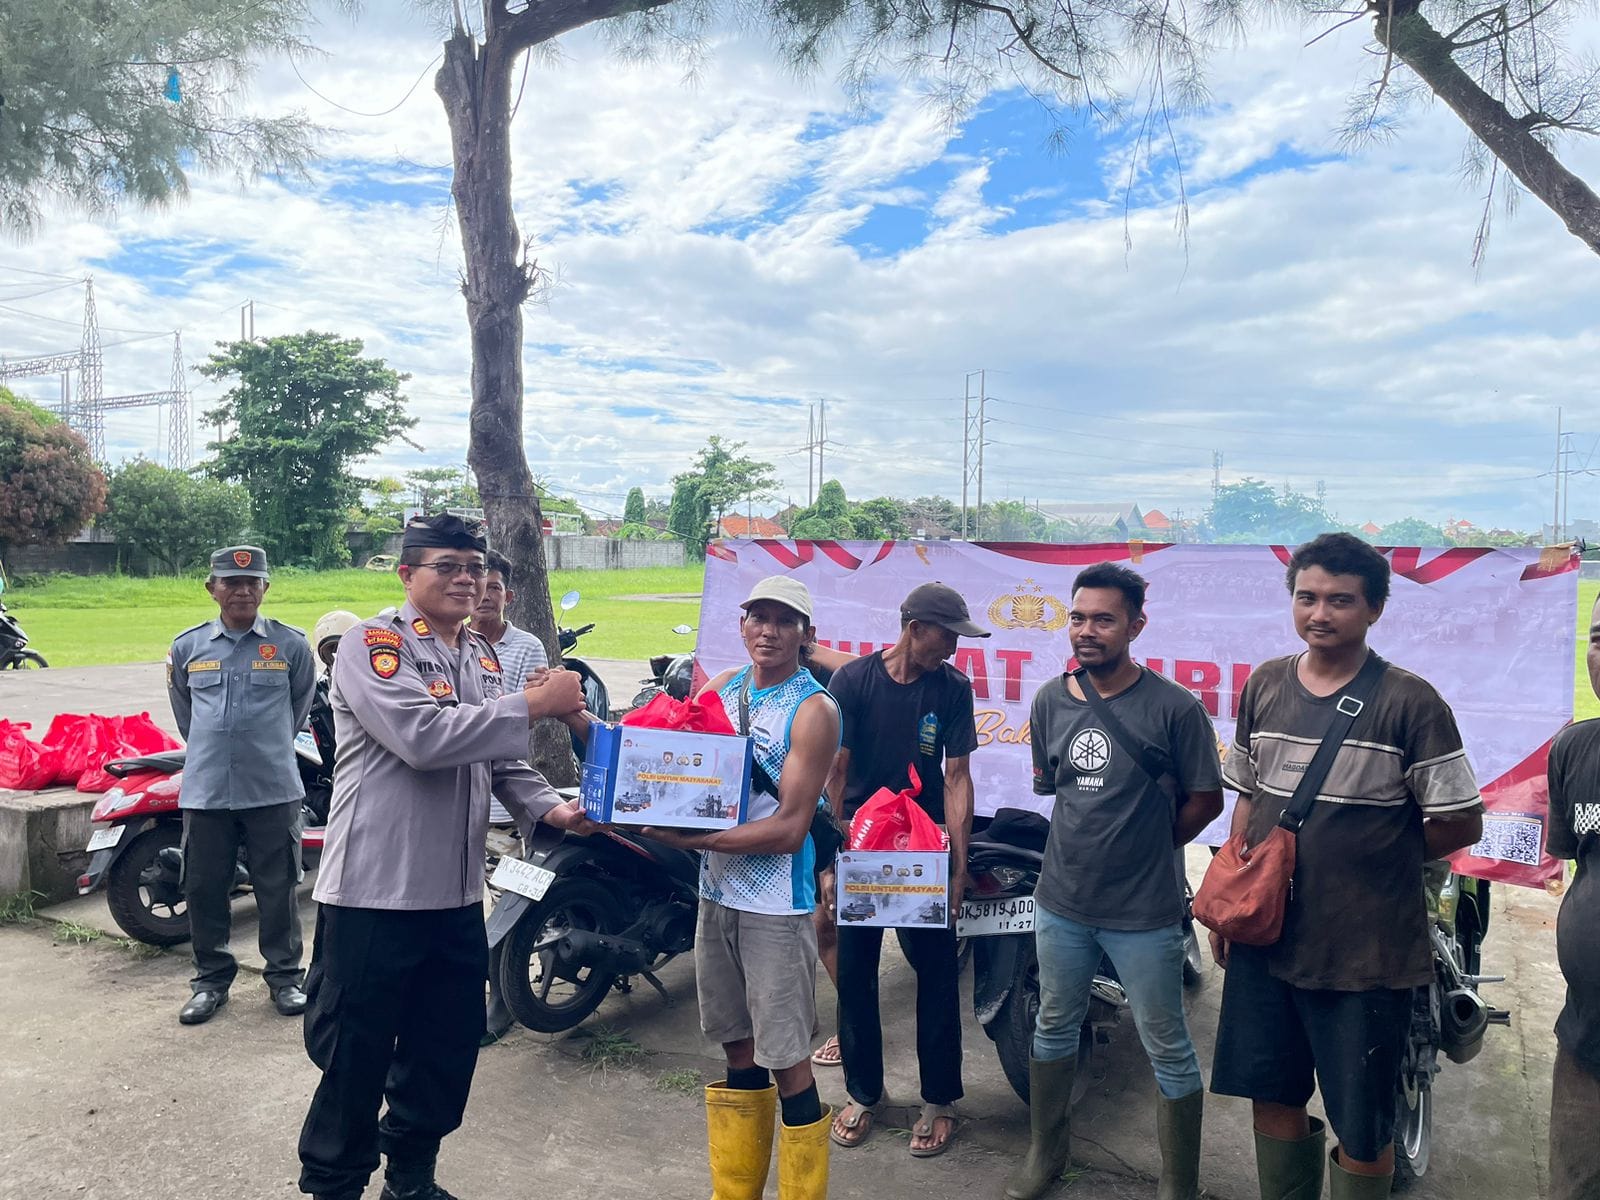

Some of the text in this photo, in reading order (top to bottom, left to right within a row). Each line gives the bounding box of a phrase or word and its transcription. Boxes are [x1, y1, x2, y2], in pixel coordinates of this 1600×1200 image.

[657, 774, 679, 782] UNTUK
[1076, 776, 1104, 787] YAMAHA
[509, 861, 535, 879] 3442
[844, 884, 871, 892] POLRI
[872, 885, 901, 893] UNTUK
[976, 902, 1006, 917] 5819
